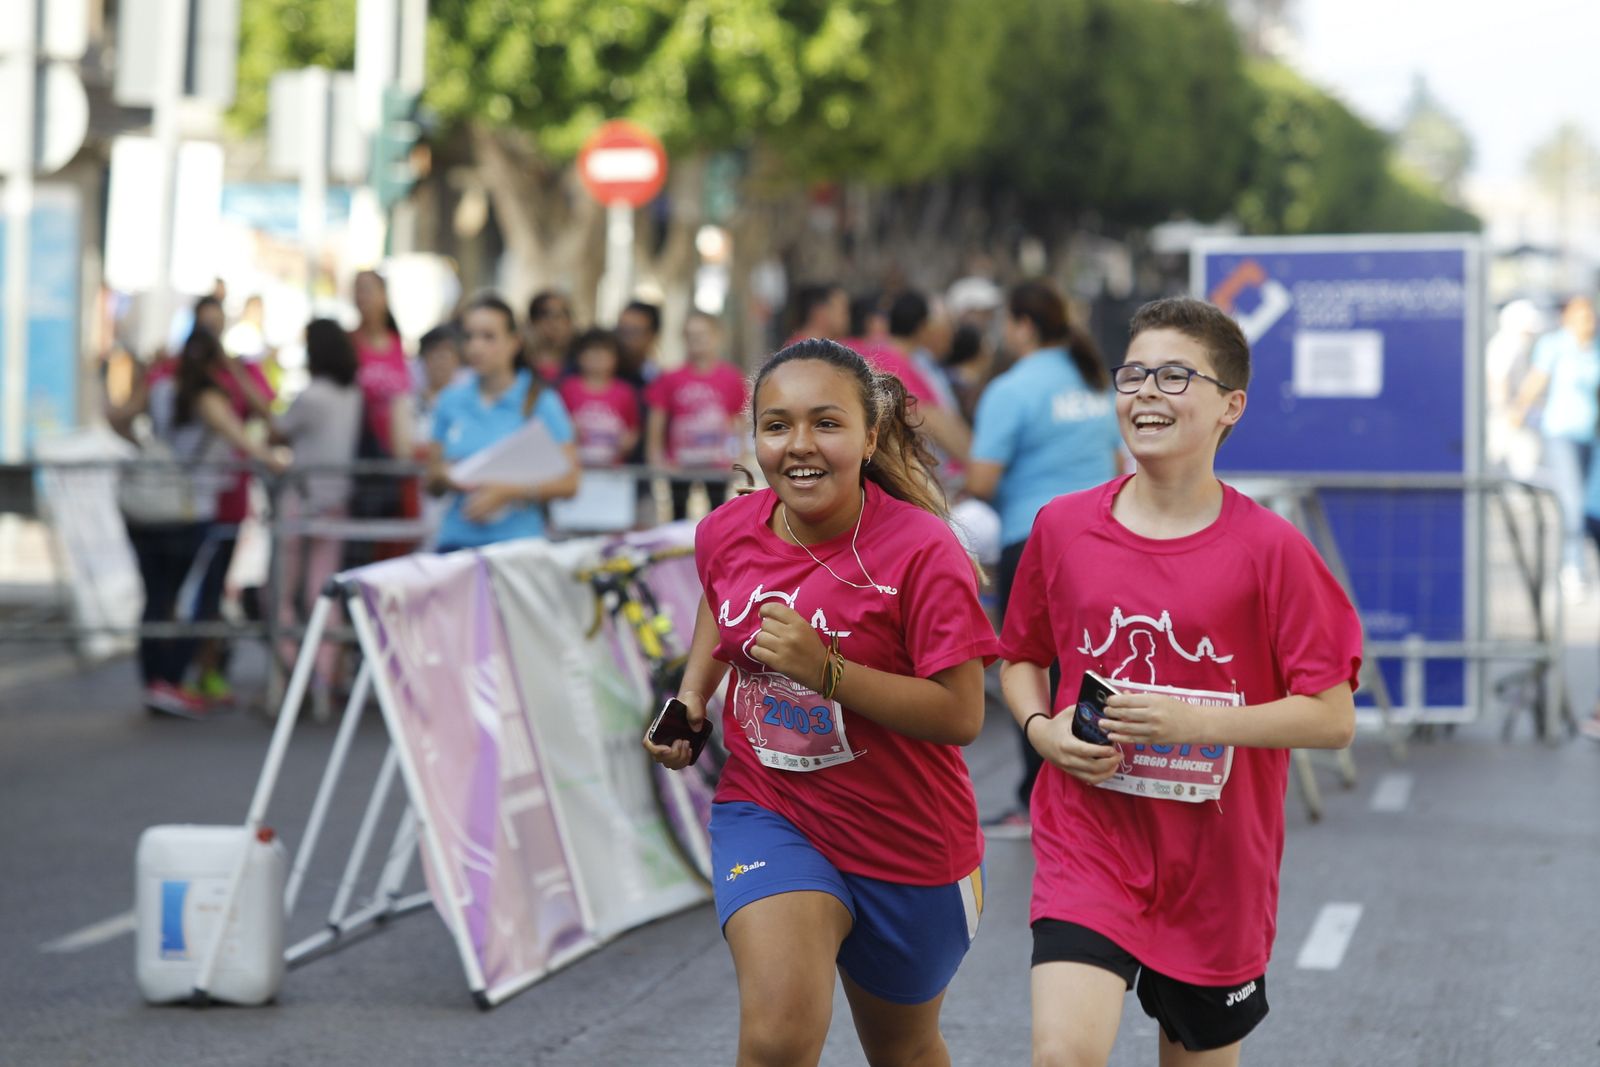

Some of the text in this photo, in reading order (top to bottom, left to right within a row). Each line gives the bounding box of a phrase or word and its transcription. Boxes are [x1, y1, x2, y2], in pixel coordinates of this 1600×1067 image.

[763, 696, 833, 735] 2003
[1133, 755, 1214, 773] SERGIO SÁNCHEZ
[1226, 980, 1257, 1006] Joma
